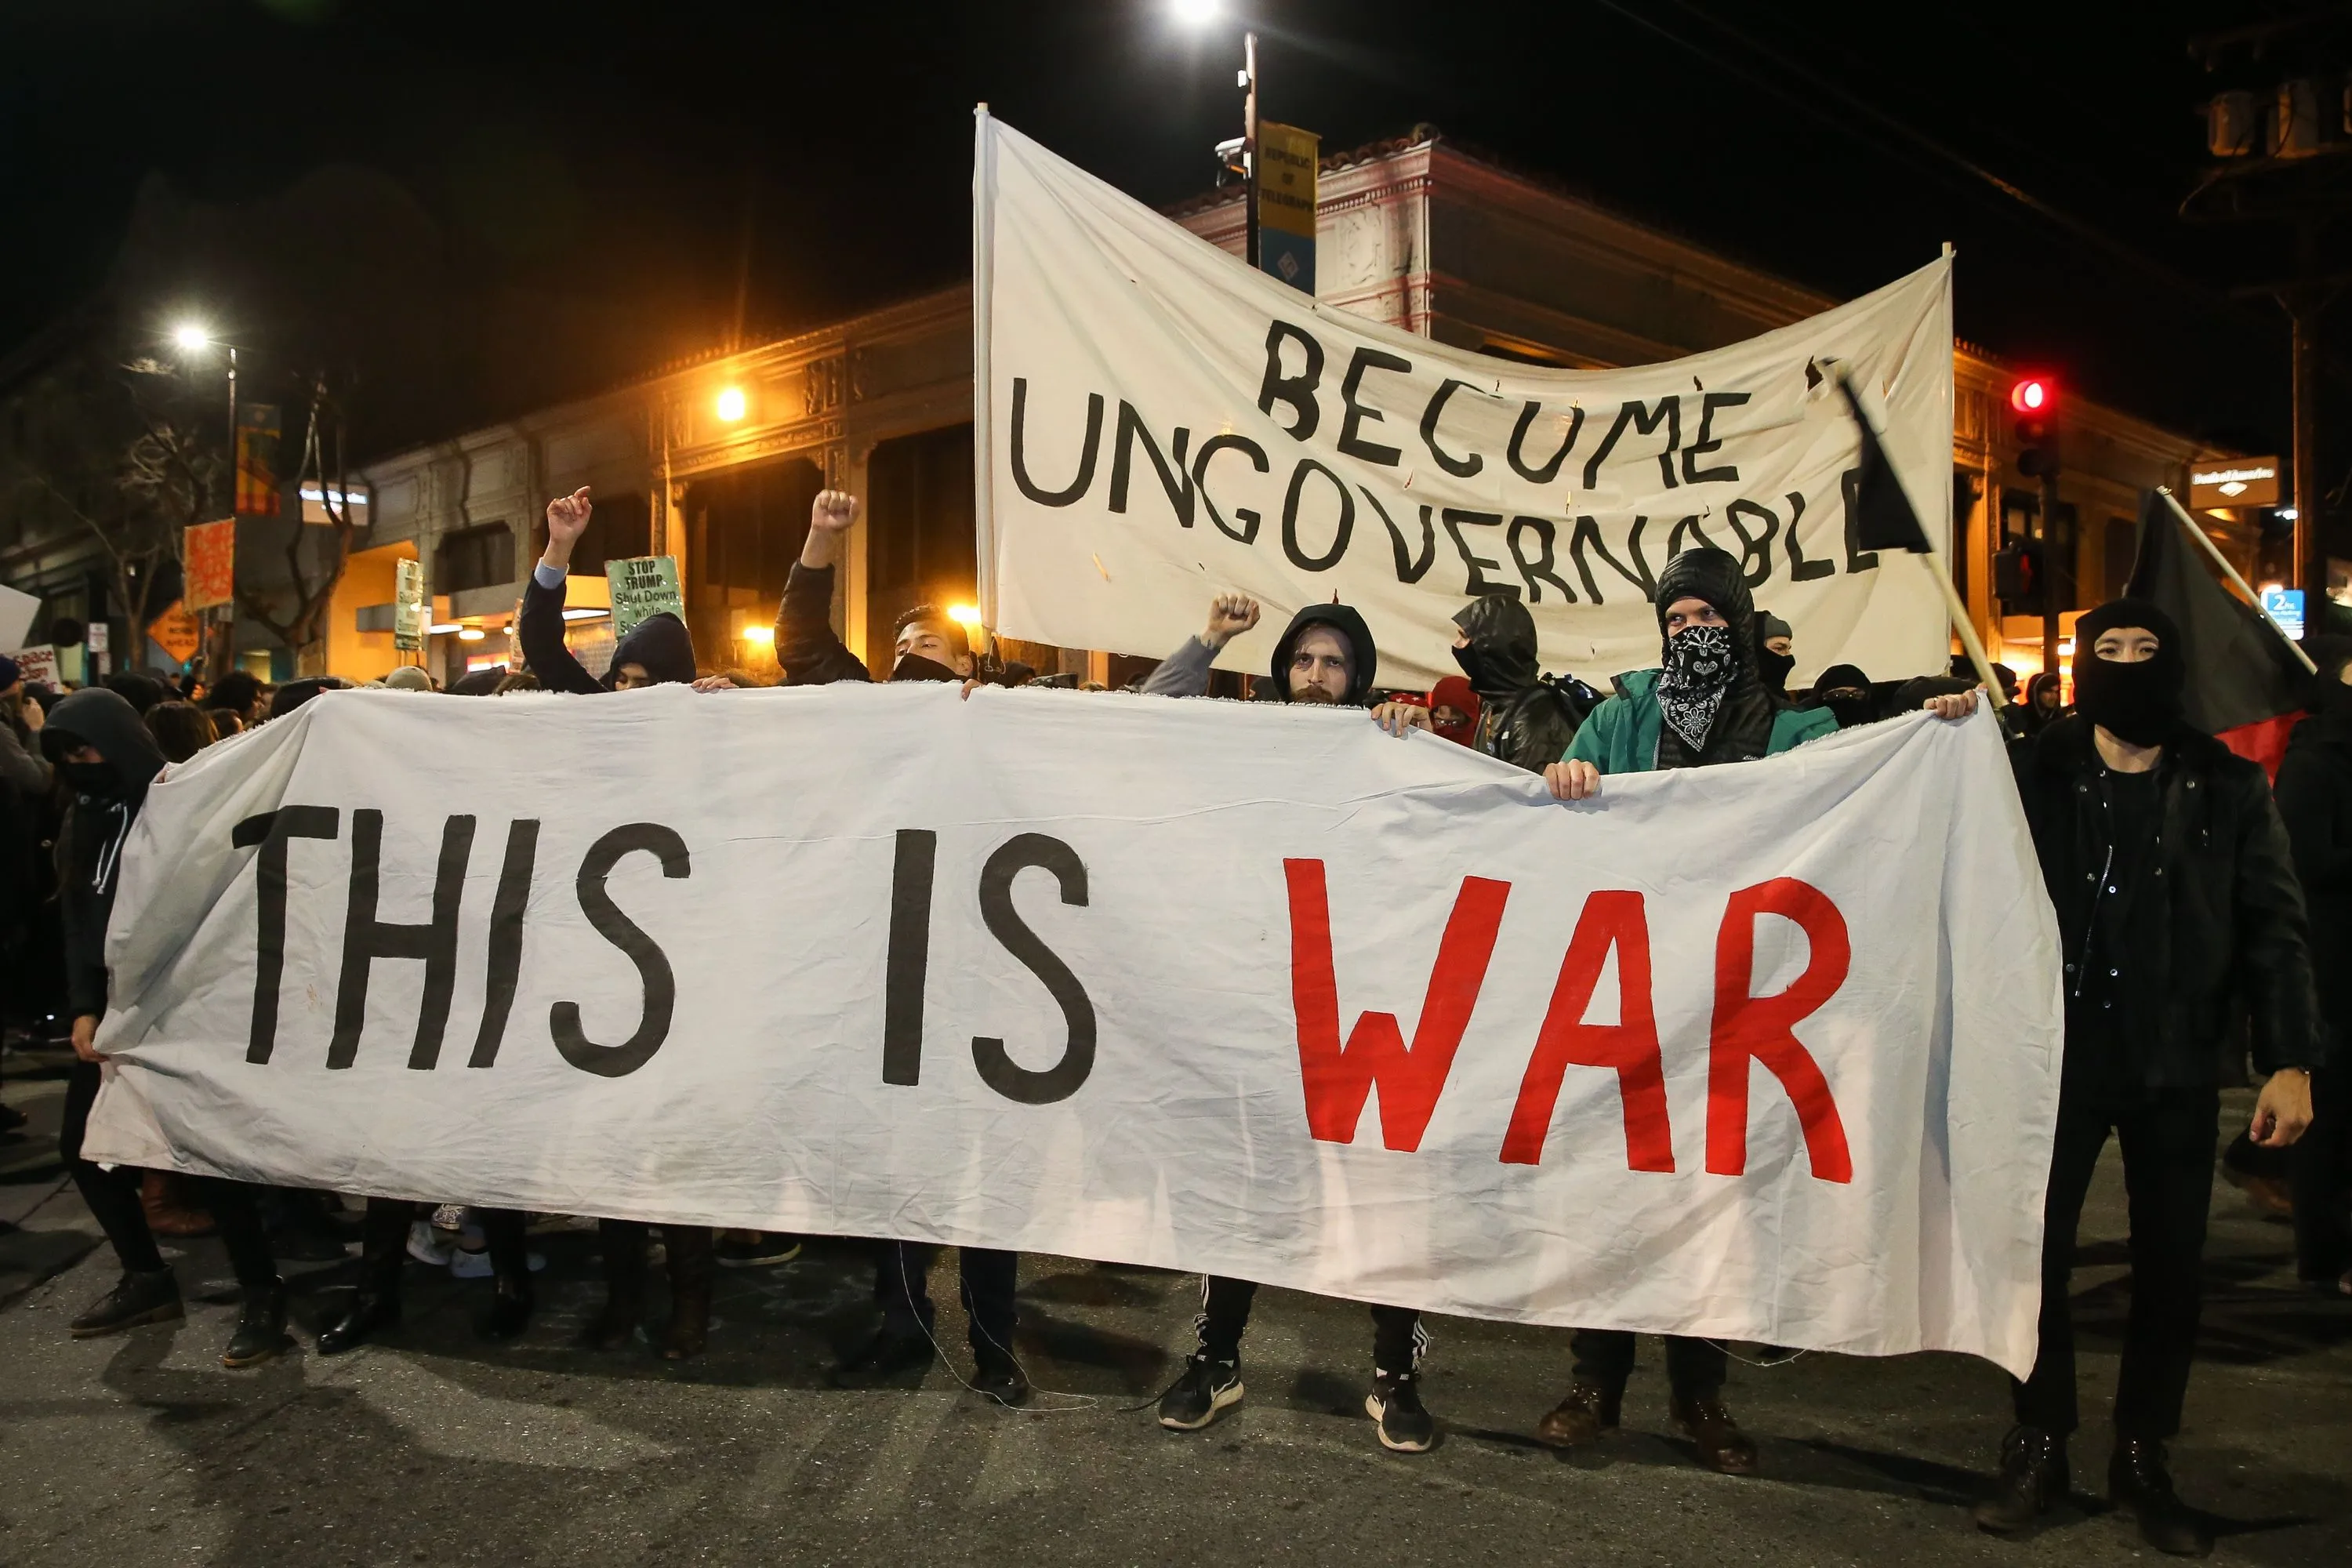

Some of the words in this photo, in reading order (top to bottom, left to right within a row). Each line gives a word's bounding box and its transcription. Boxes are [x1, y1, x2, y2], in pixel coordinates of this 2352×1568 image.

[628, 561, 655, 575] STOP
[624, 574, 662, 590] TRUMP
[615, 592, 641, 604] Shut
[644, 590, 677, 603] Down
[232, 805, 691, 1077] THIS
[883, 829, 1097, 1104] IS
[1283, 858, 1853, 1184] WAR
